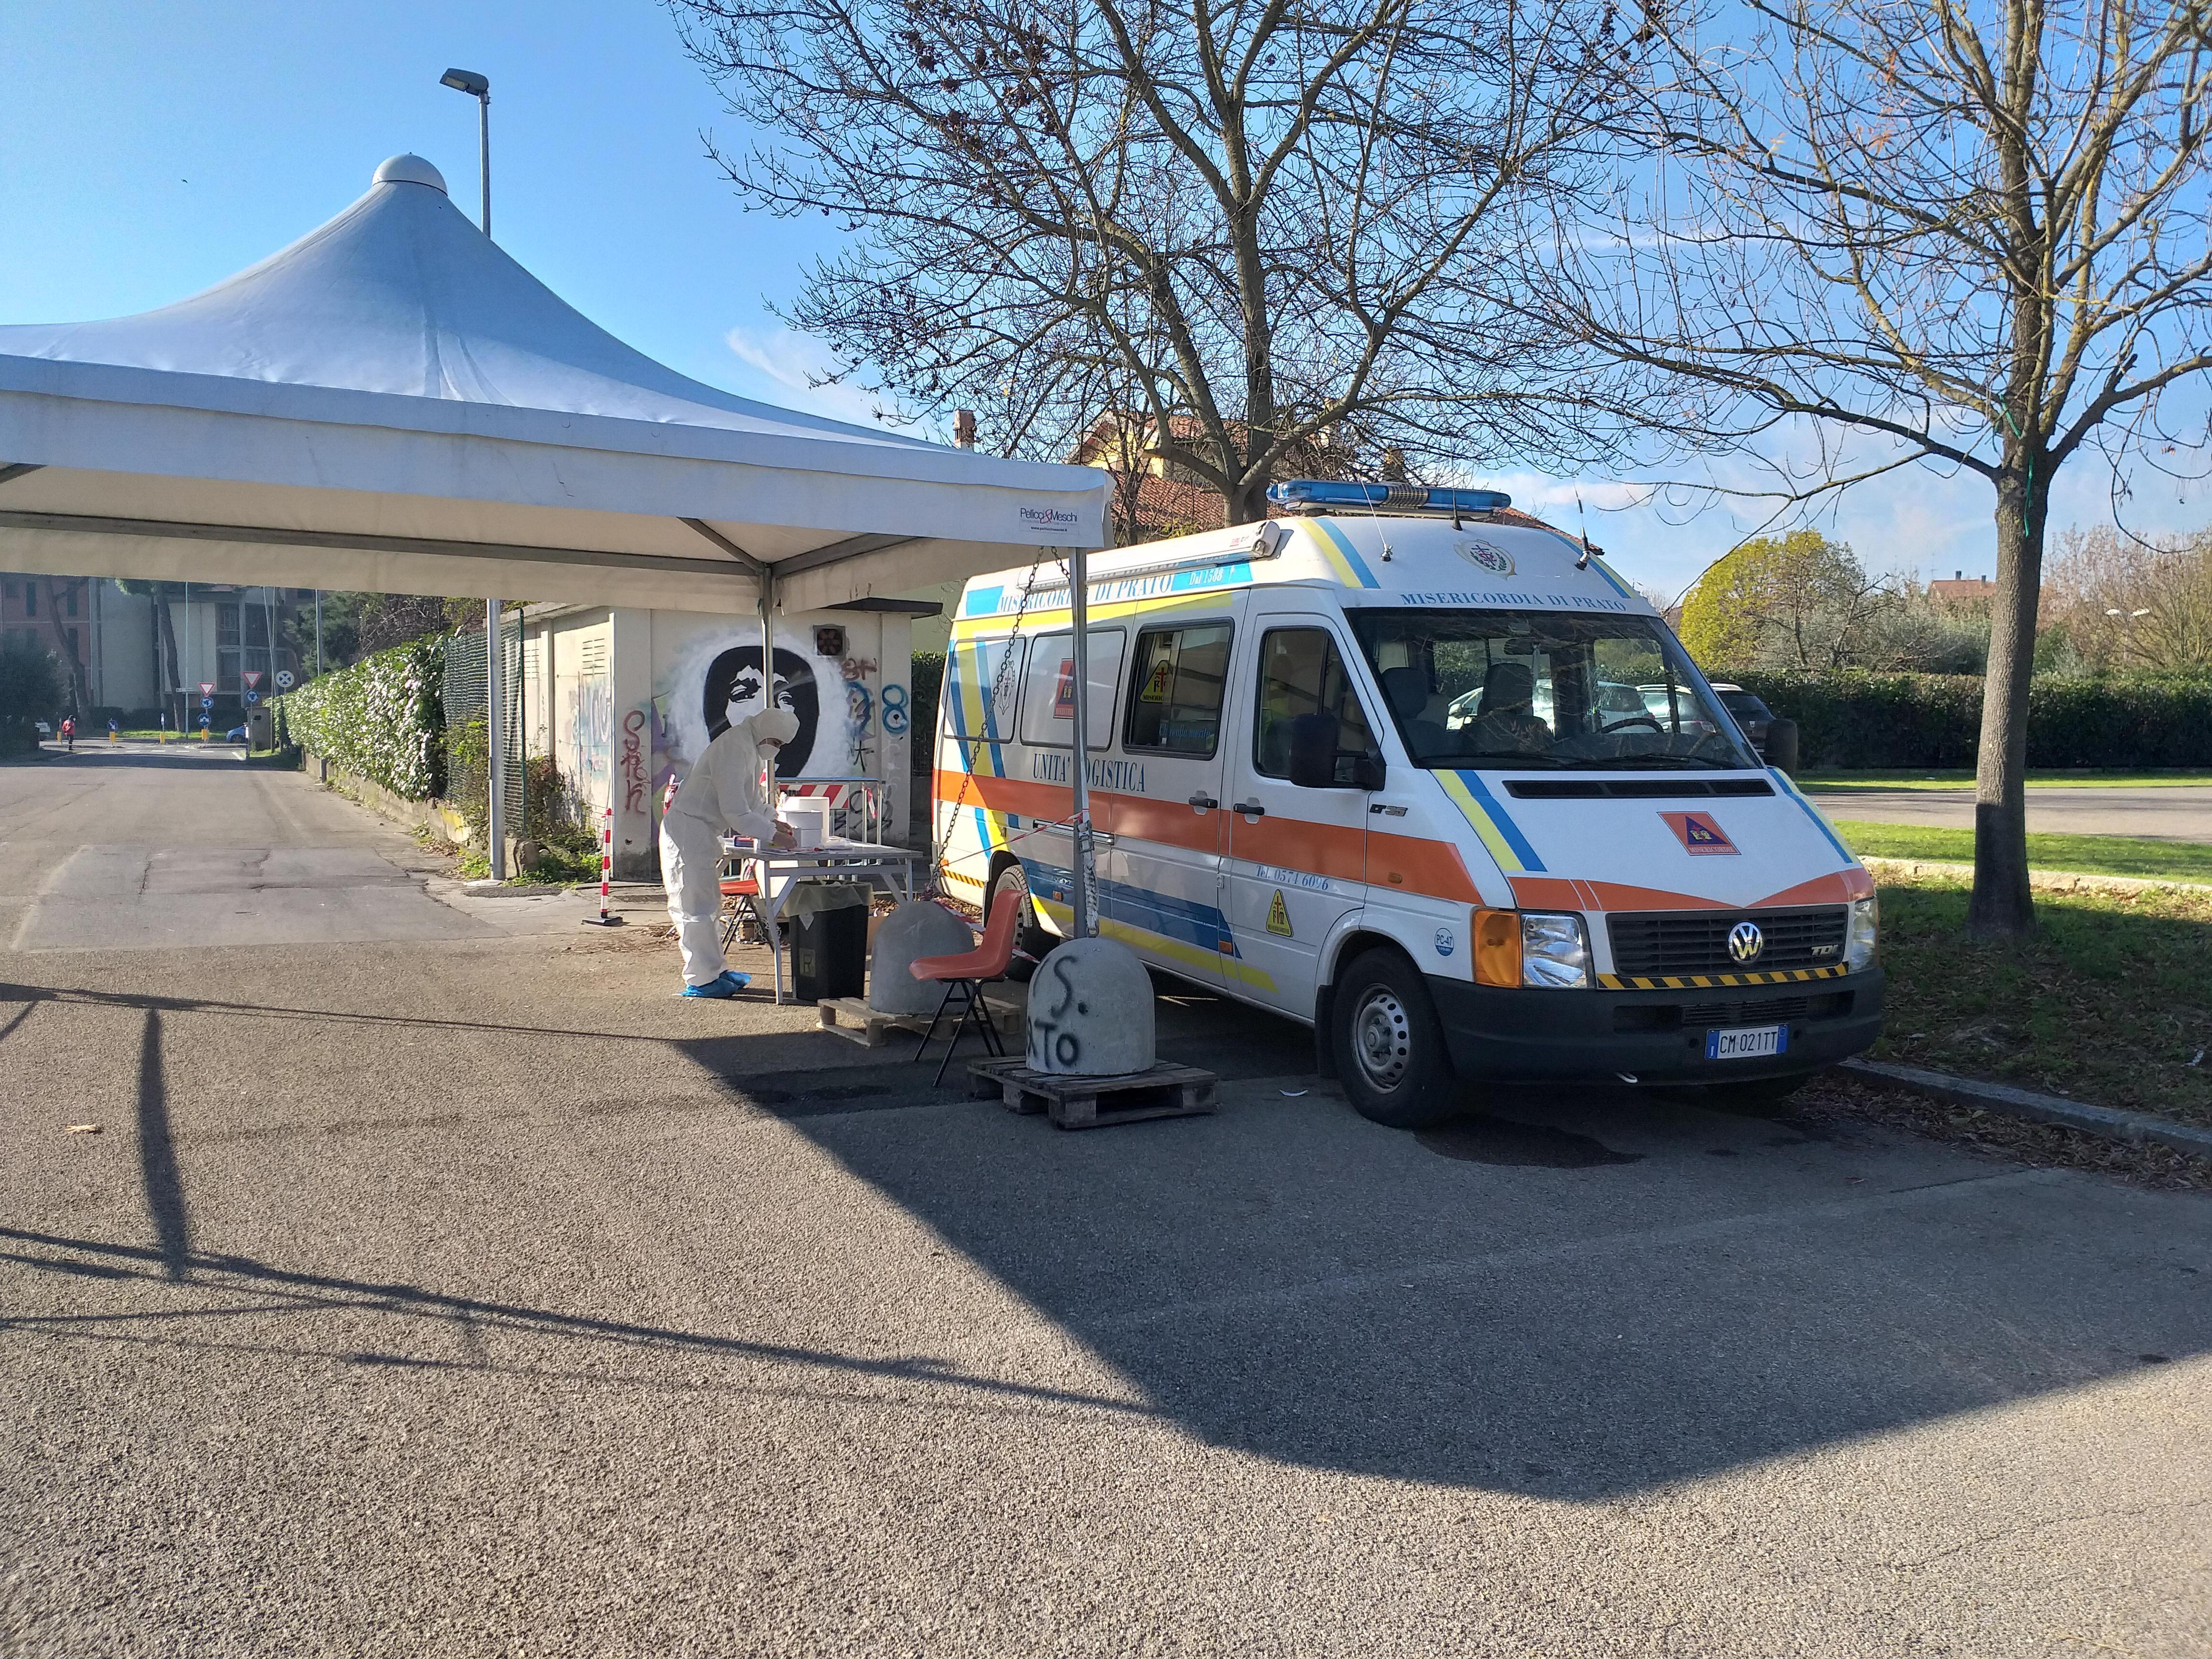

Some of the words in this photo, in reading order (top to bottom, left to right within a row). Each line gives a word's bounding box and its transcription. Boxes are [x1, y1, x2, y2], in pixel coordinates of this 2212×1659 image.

[1189, 571, 1202, 585] Dal
[1202, 568, 1224, 584] 1588
[1094, 582, 1113, 601] DI
[1116, 574, 1172, 599] PRATO
[1399, 592, 1544, 605] MISERICORDIA
[1547, 595, 1570, 606] DI
[1571, 596, 1626, 612] PRATO
[1033, 753, 1070, 782] UNITA'
[1256, 865, 1270, 879] Tel.
[1274, 868, 1298, 884] 0574
[1301, 874, 1329, 891] 6096
[1436, 934, 1452, 946] PC-47
[1811, 944, 1839, 956] TDI
[1720, 1035, 1736, 1053] CM
[1740, 1031, 1778, 1051] 021TT
